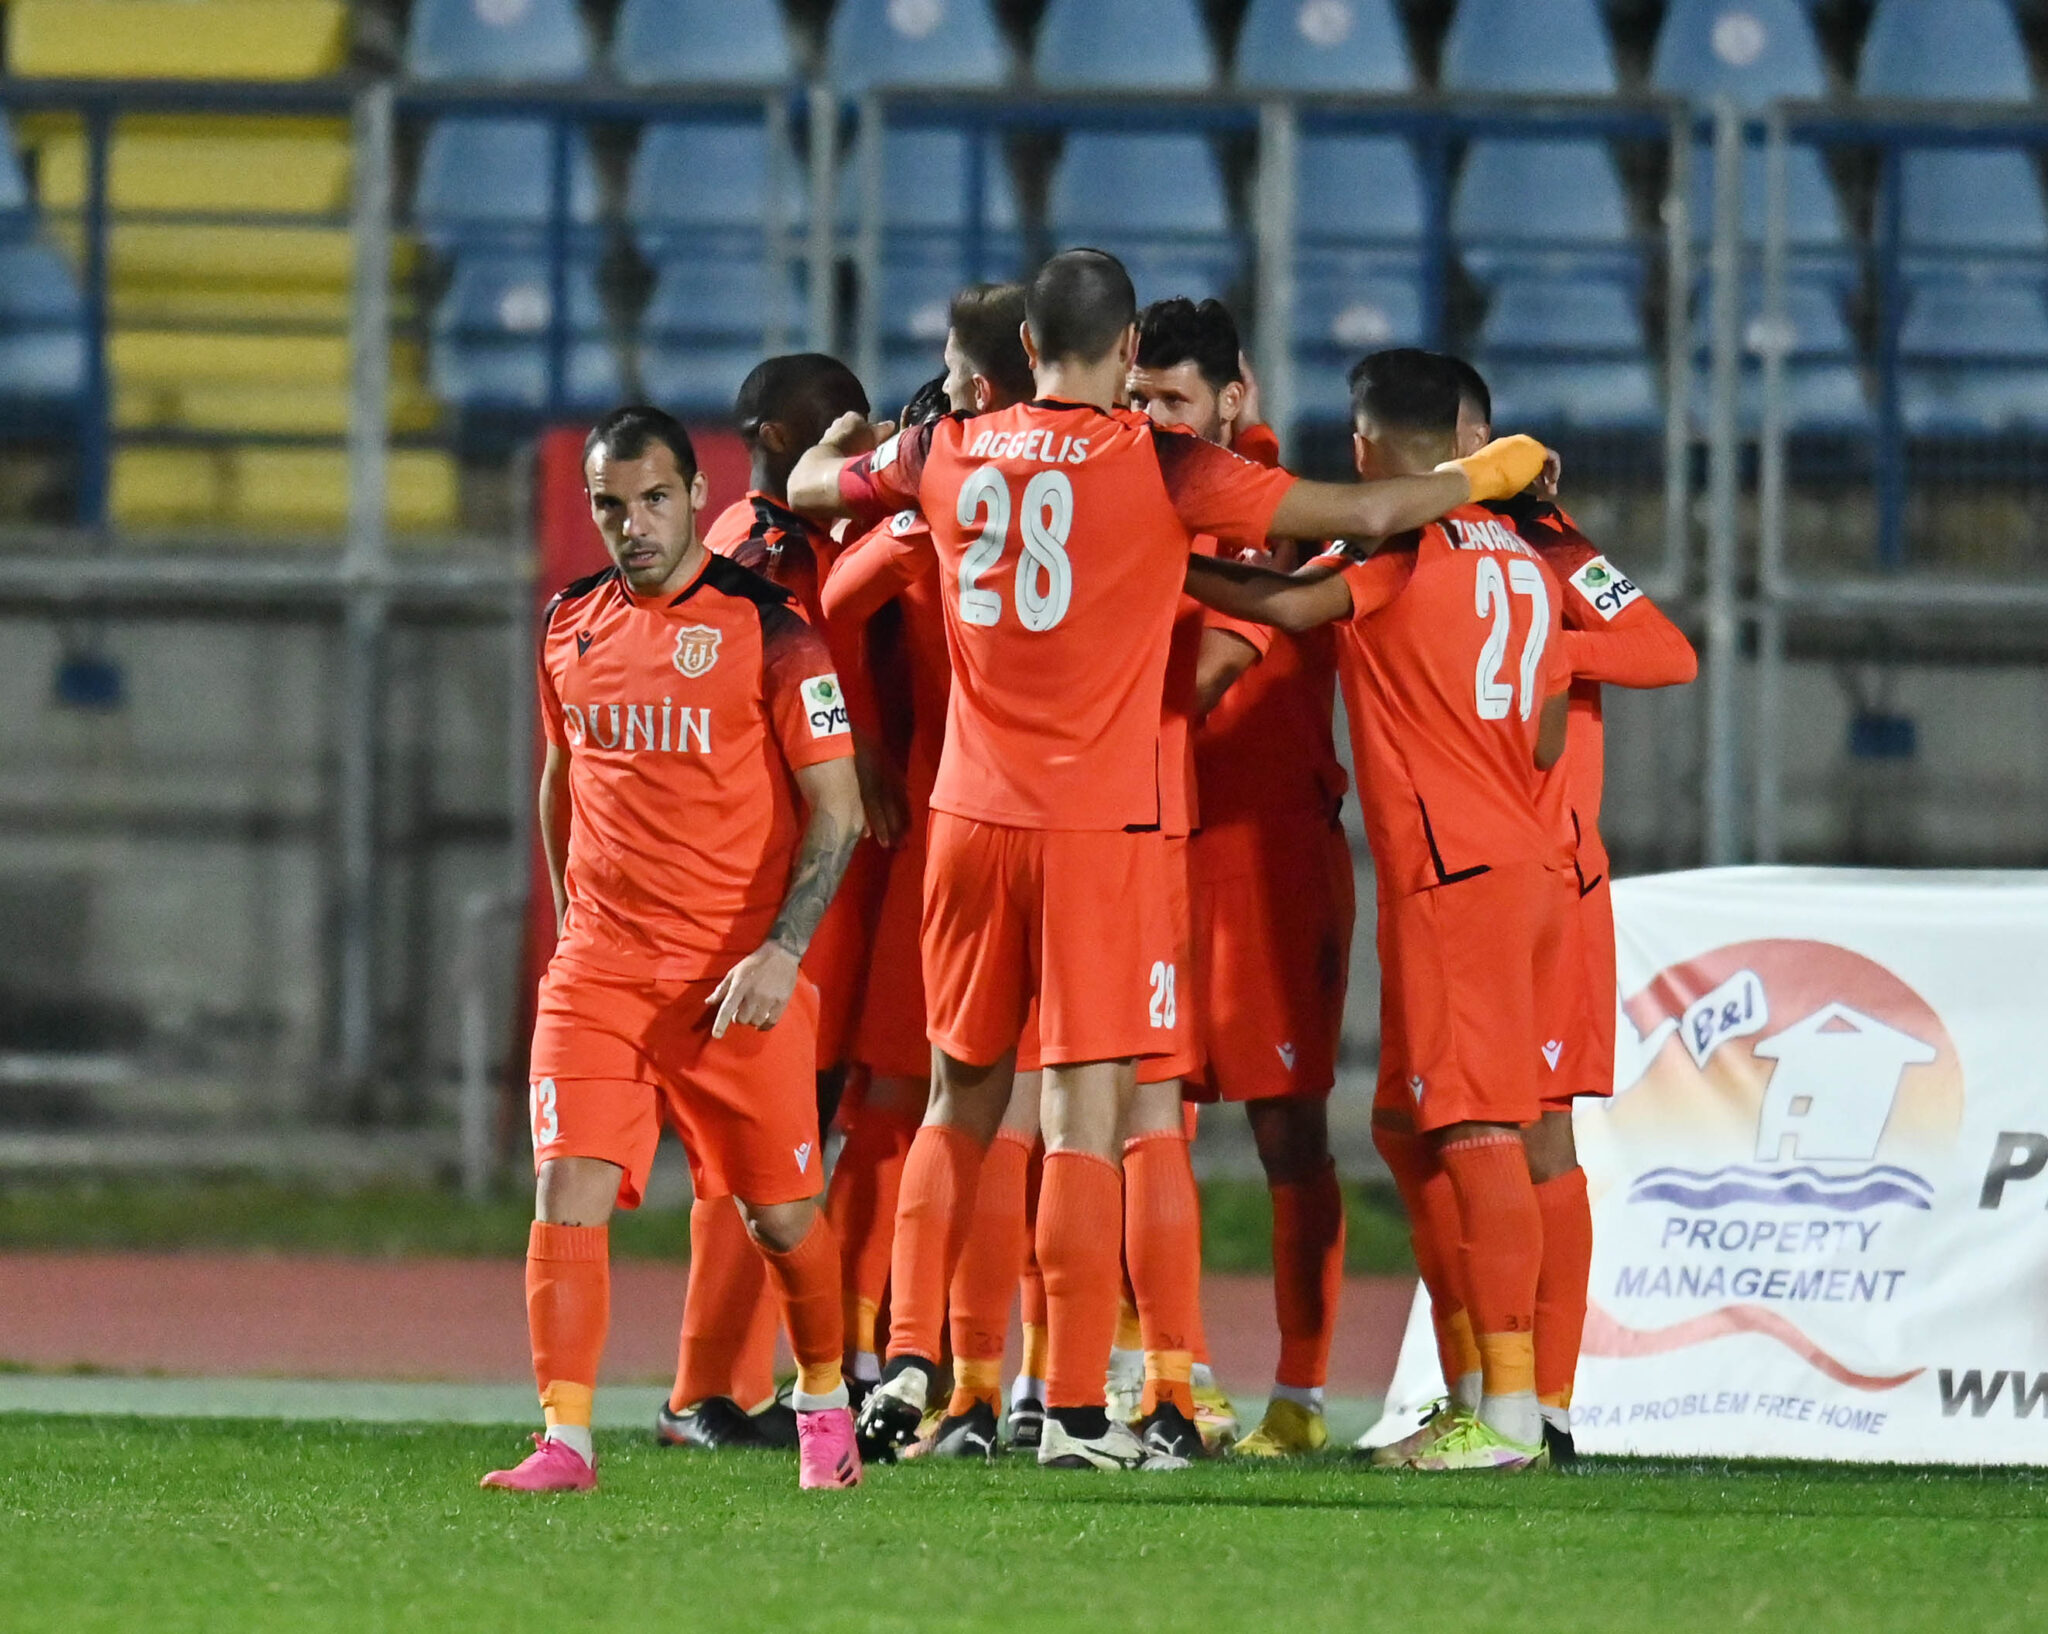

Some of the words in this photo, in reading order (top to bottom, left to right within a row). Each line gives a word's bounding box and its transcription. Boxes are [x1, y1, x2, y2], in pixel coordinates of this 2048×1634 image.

[969, 430, 1090, 464] AGGELIS
[956, 466, 1074, 632] 28
[1595, 579, 1636, 611] cyta
[1475, 556, 1550, 722] 27
[1149, 960, 1176, 1029] 28
[1661, 1217, 1881, 1253] PROPERTY
[1614, 1265, 1906, 1303] MANAGEMENT
[1605, 1404, 1622, 1426] A
[1628, 1392, 1749, 1423] PROBLEM
[1753, 1394, 1815, 1421] FREE
[1818, 1405, 1888, 1435] HOME
